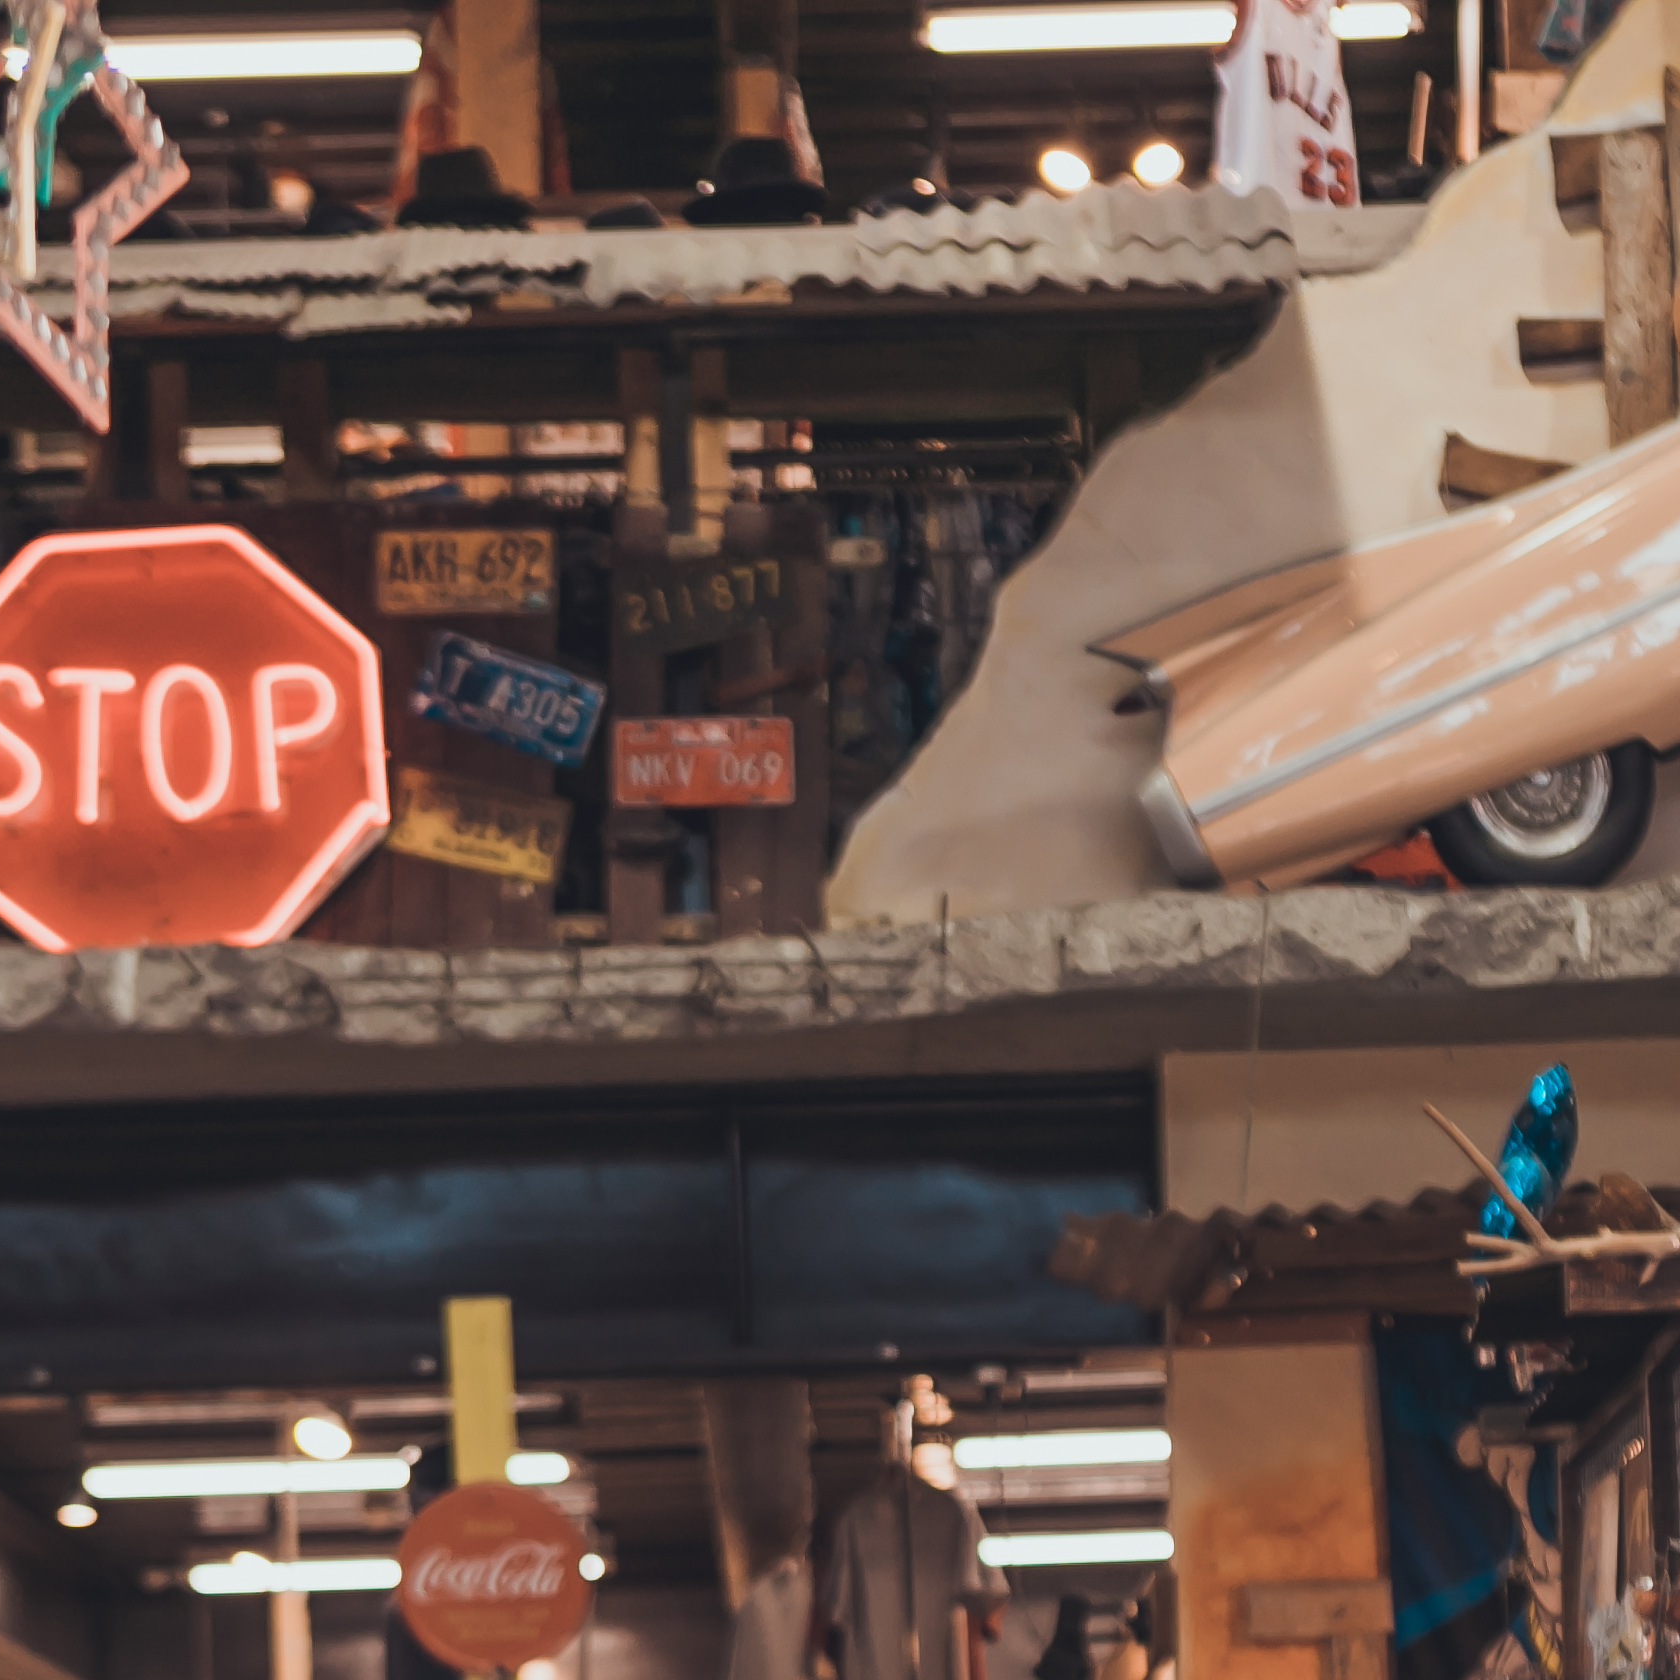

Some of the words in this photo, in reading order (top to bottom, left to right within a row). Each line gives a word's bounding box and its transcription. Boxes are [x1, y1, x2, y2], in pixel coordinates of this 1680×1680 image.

[1299, 136, 1358, 208] 23
[387, 540, 459, 584] AKH
[475, 538, 546, 586] 692
[627, 752, 696, 788] NKV
[405, 1539, 566, 1605] Coca-Cola
